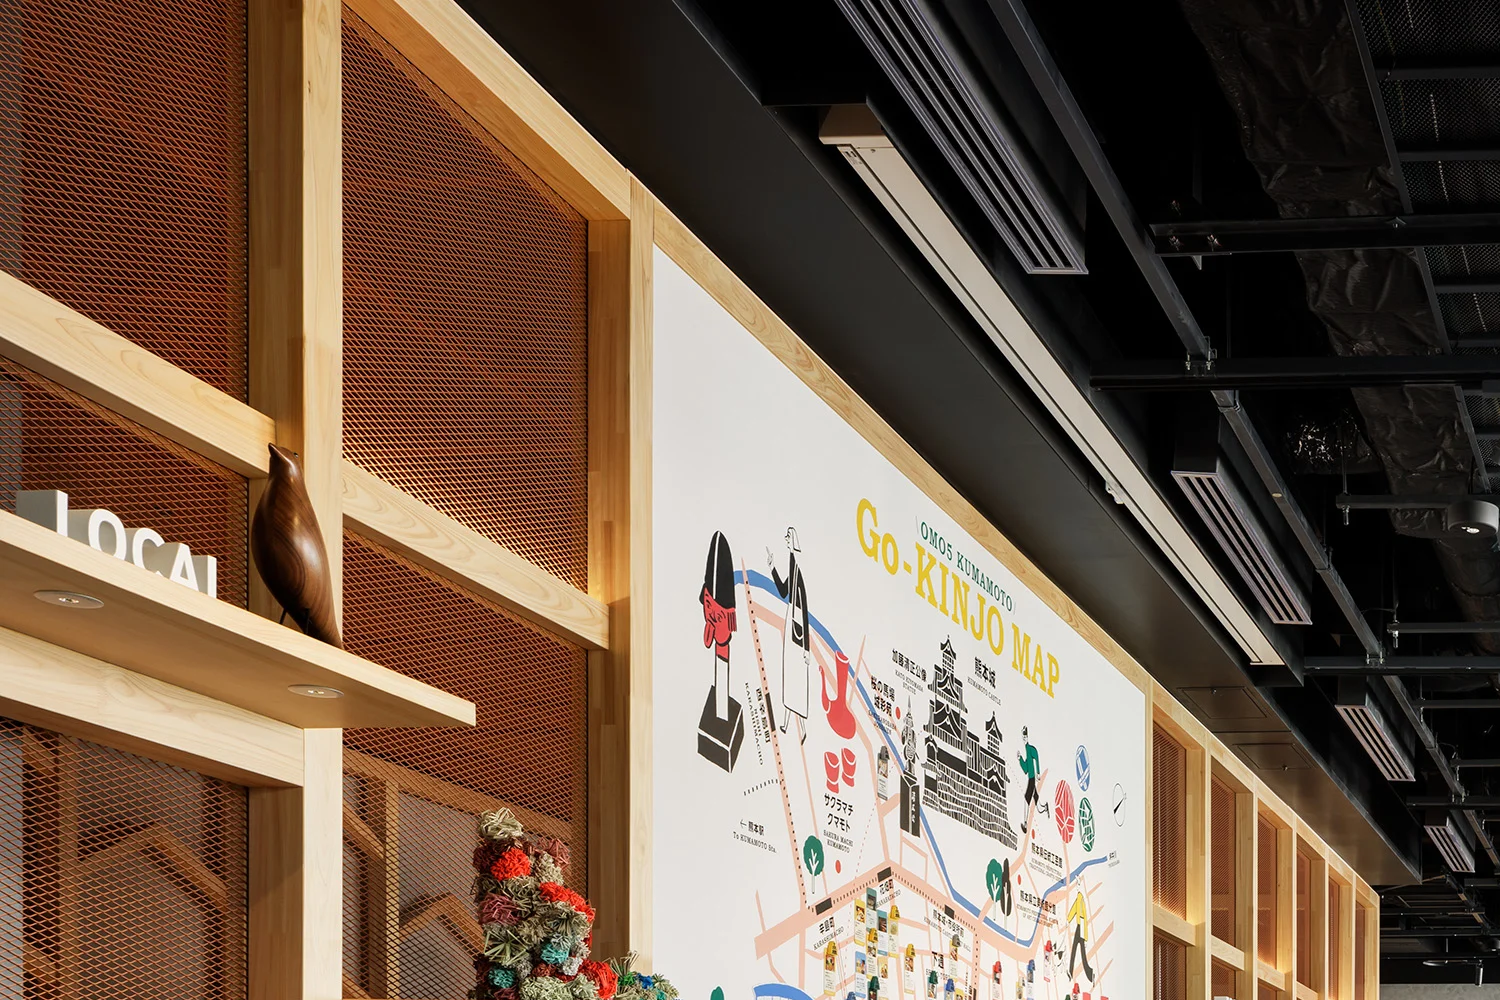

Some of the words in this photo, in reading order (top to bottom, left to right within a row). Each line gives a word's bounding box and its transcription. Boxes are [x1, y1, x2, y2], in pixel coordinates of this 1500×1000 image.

[920, 521, 953, 561] OMO5
[956, 551, 1013, 612] KUMAMOTO
[856, 498, 1005, 656] Go-KINJO
[1011, 622, 1060, 699] MAP
[974, 656, 997, 689] 熊本城
[824, 793, 854, 816] サクラマチ
[748, 820, 765, 837] 熊本駅
[827, 813, 851, 832] クマモト
[740, 835, 768, 851] KUMAMOTO
[827, 839, 850, 853] KUMAMOTO
[931, 951, 944, 969] 下通
